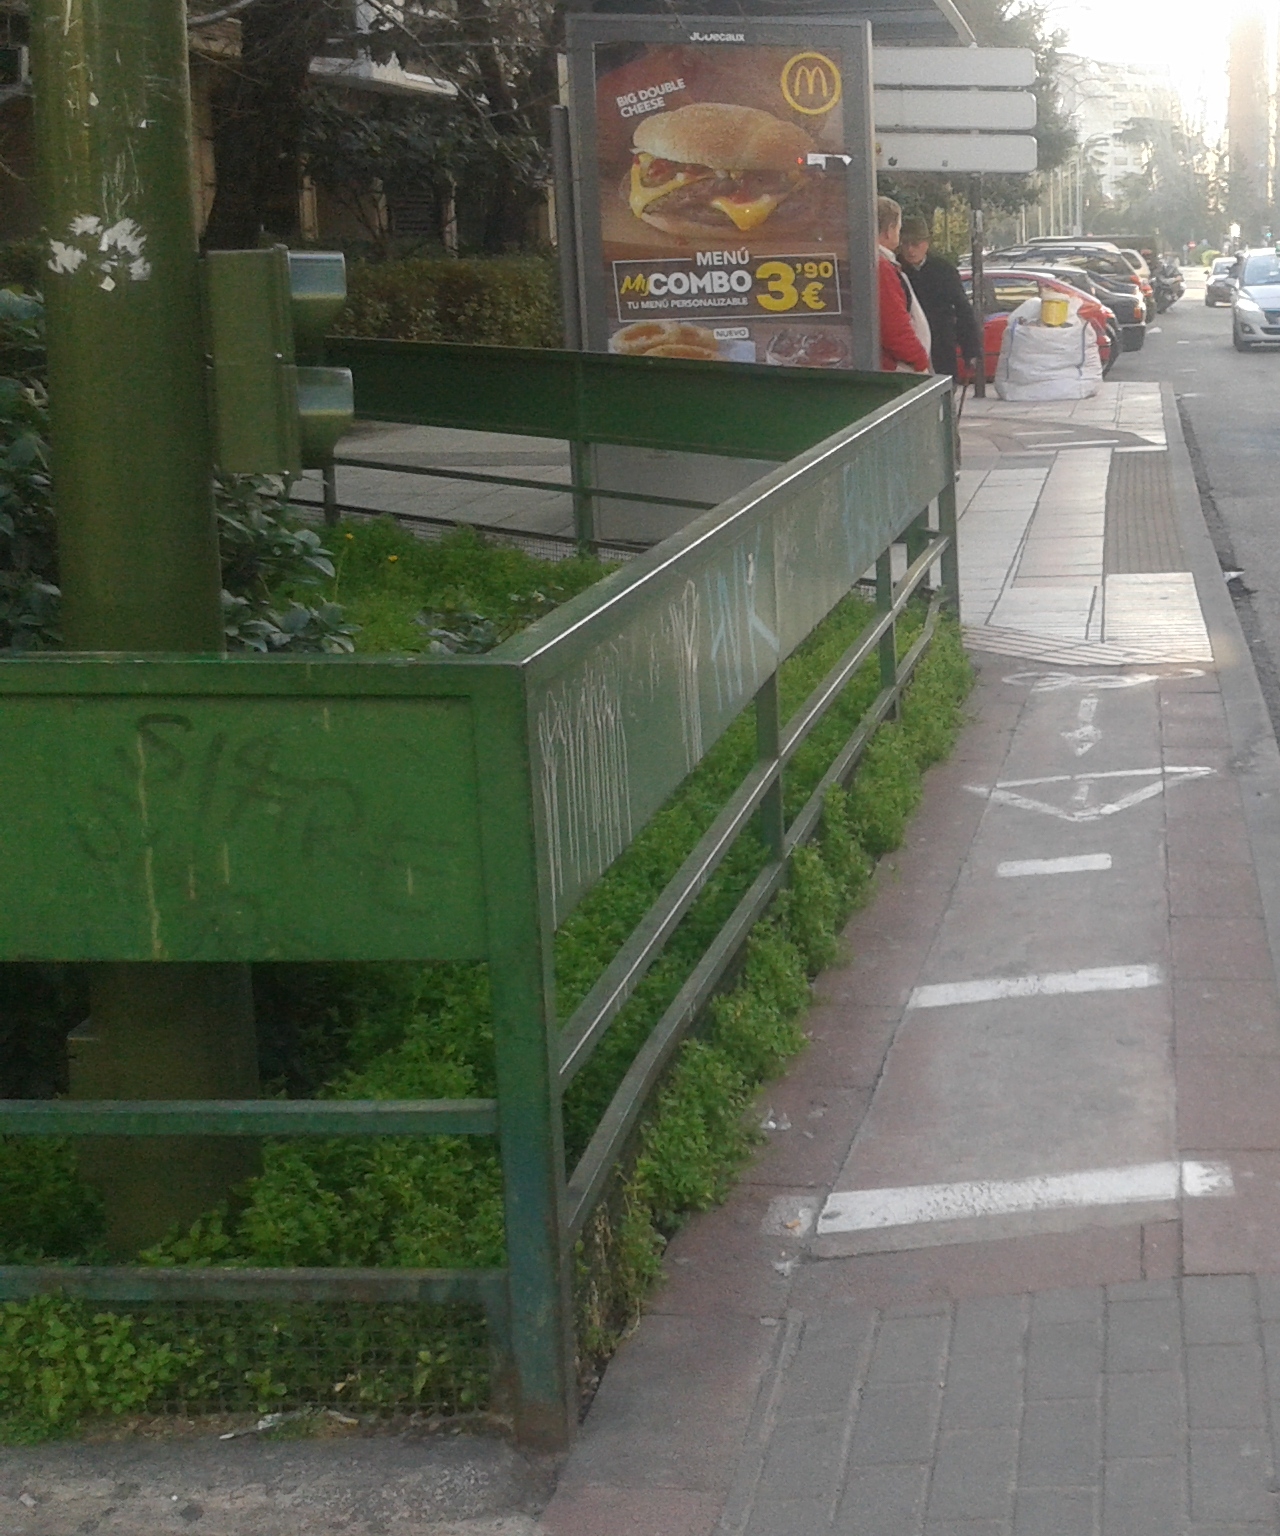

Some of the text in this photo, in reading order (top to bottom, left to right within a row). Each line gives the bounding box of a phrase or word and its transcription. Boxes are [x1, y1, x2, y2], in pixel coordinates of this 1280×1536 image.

[616, 78, 686, 108] BIG DOUBLE
[620, 96, 666, 118] CHEESE
[696, 246, 750, 266] MENÚ
[627, 297, 749, 310] TU MENÚ PERSONALIZABLE
[716, 328, 747, 338] NUEVO
